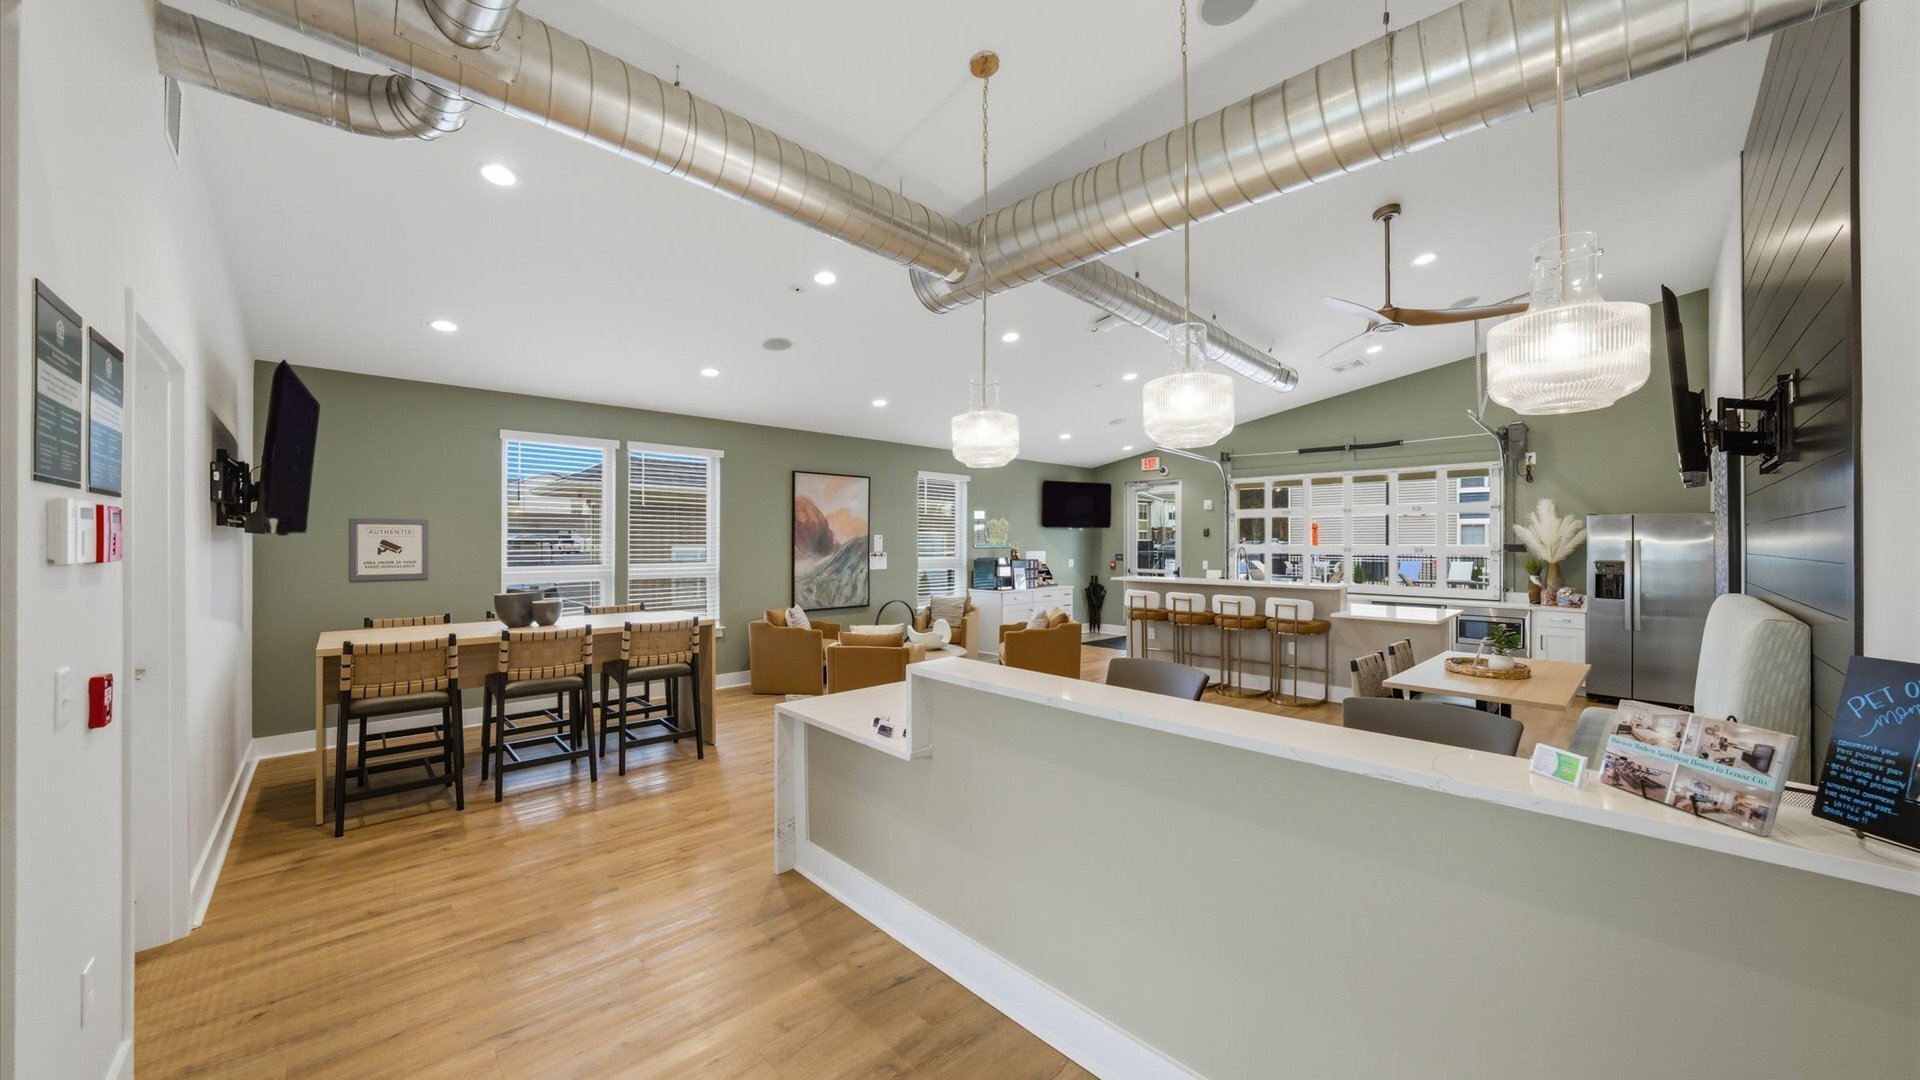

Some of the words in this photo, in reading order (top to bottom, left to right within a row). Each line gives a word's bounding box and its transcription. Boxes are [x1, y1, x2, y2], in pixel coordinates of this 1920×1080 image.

[1847, 686, 1894, 718] PET
[1904, 679, 1920, 698] O
[1610, 737, 1634, 746] Discover
[1634, 742, 1656, 753] Modern
[1656, 748, 1689, 763] Apartment
[1690, 759, 1715, 770] Homes
[1716, 765, 1724, 773] in
[1752, 776, 1770, 787] City
